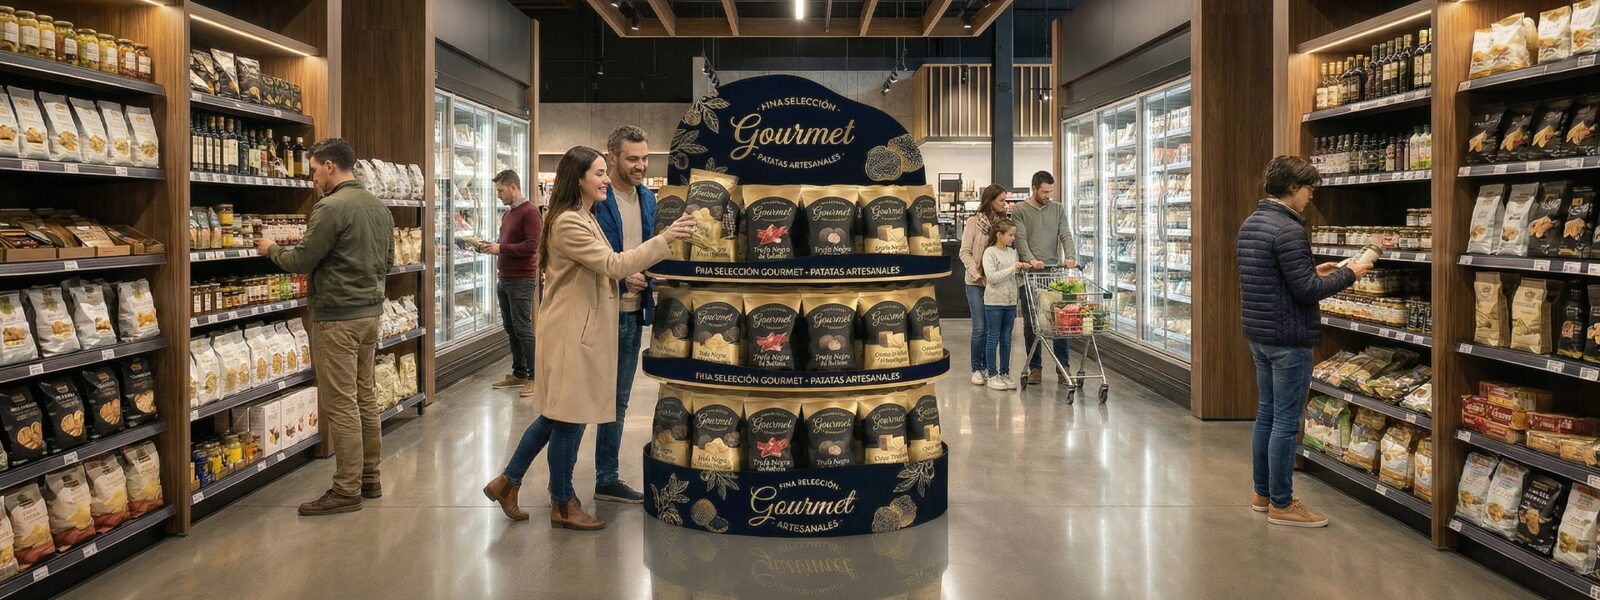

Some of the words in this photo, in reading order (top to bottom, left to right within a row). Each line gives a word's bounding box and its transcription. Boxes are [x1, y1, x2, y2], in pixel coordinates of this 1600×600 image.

[784, 96, 837, 112] SELECCIÓN
[729, 113, 855, 160] Gourmet
[757, 153, 788, 169] PATATAS
[788, 153, 841, 169] ARTESANALES
[752, 205, 792, 222] Gourmet
[812, 206, 852, 221] Gourmet
[714, 266, 760, 276] SELECCIÓN
[760, 267, 804, 277] GOURMET
[810, 267, 845, 277] PATATAS
[845, 265, 901, 277] ARTESANALES
[752, 312, 792, 329] Gourmet
[813, 312, 851, 328] Gourmet
[760, 376, 804, 385] GOURMET
[810, 376, 845, 386] PATATAS
[845, 372, 901, 384] ARTESANALES
[752, 416, 792, 433] Gourmet
[812, 417, 852, 433] Gourmet
[748, 485, 857, 527] Gourmet
[776, 520, 839, 533] ARTESANALES
